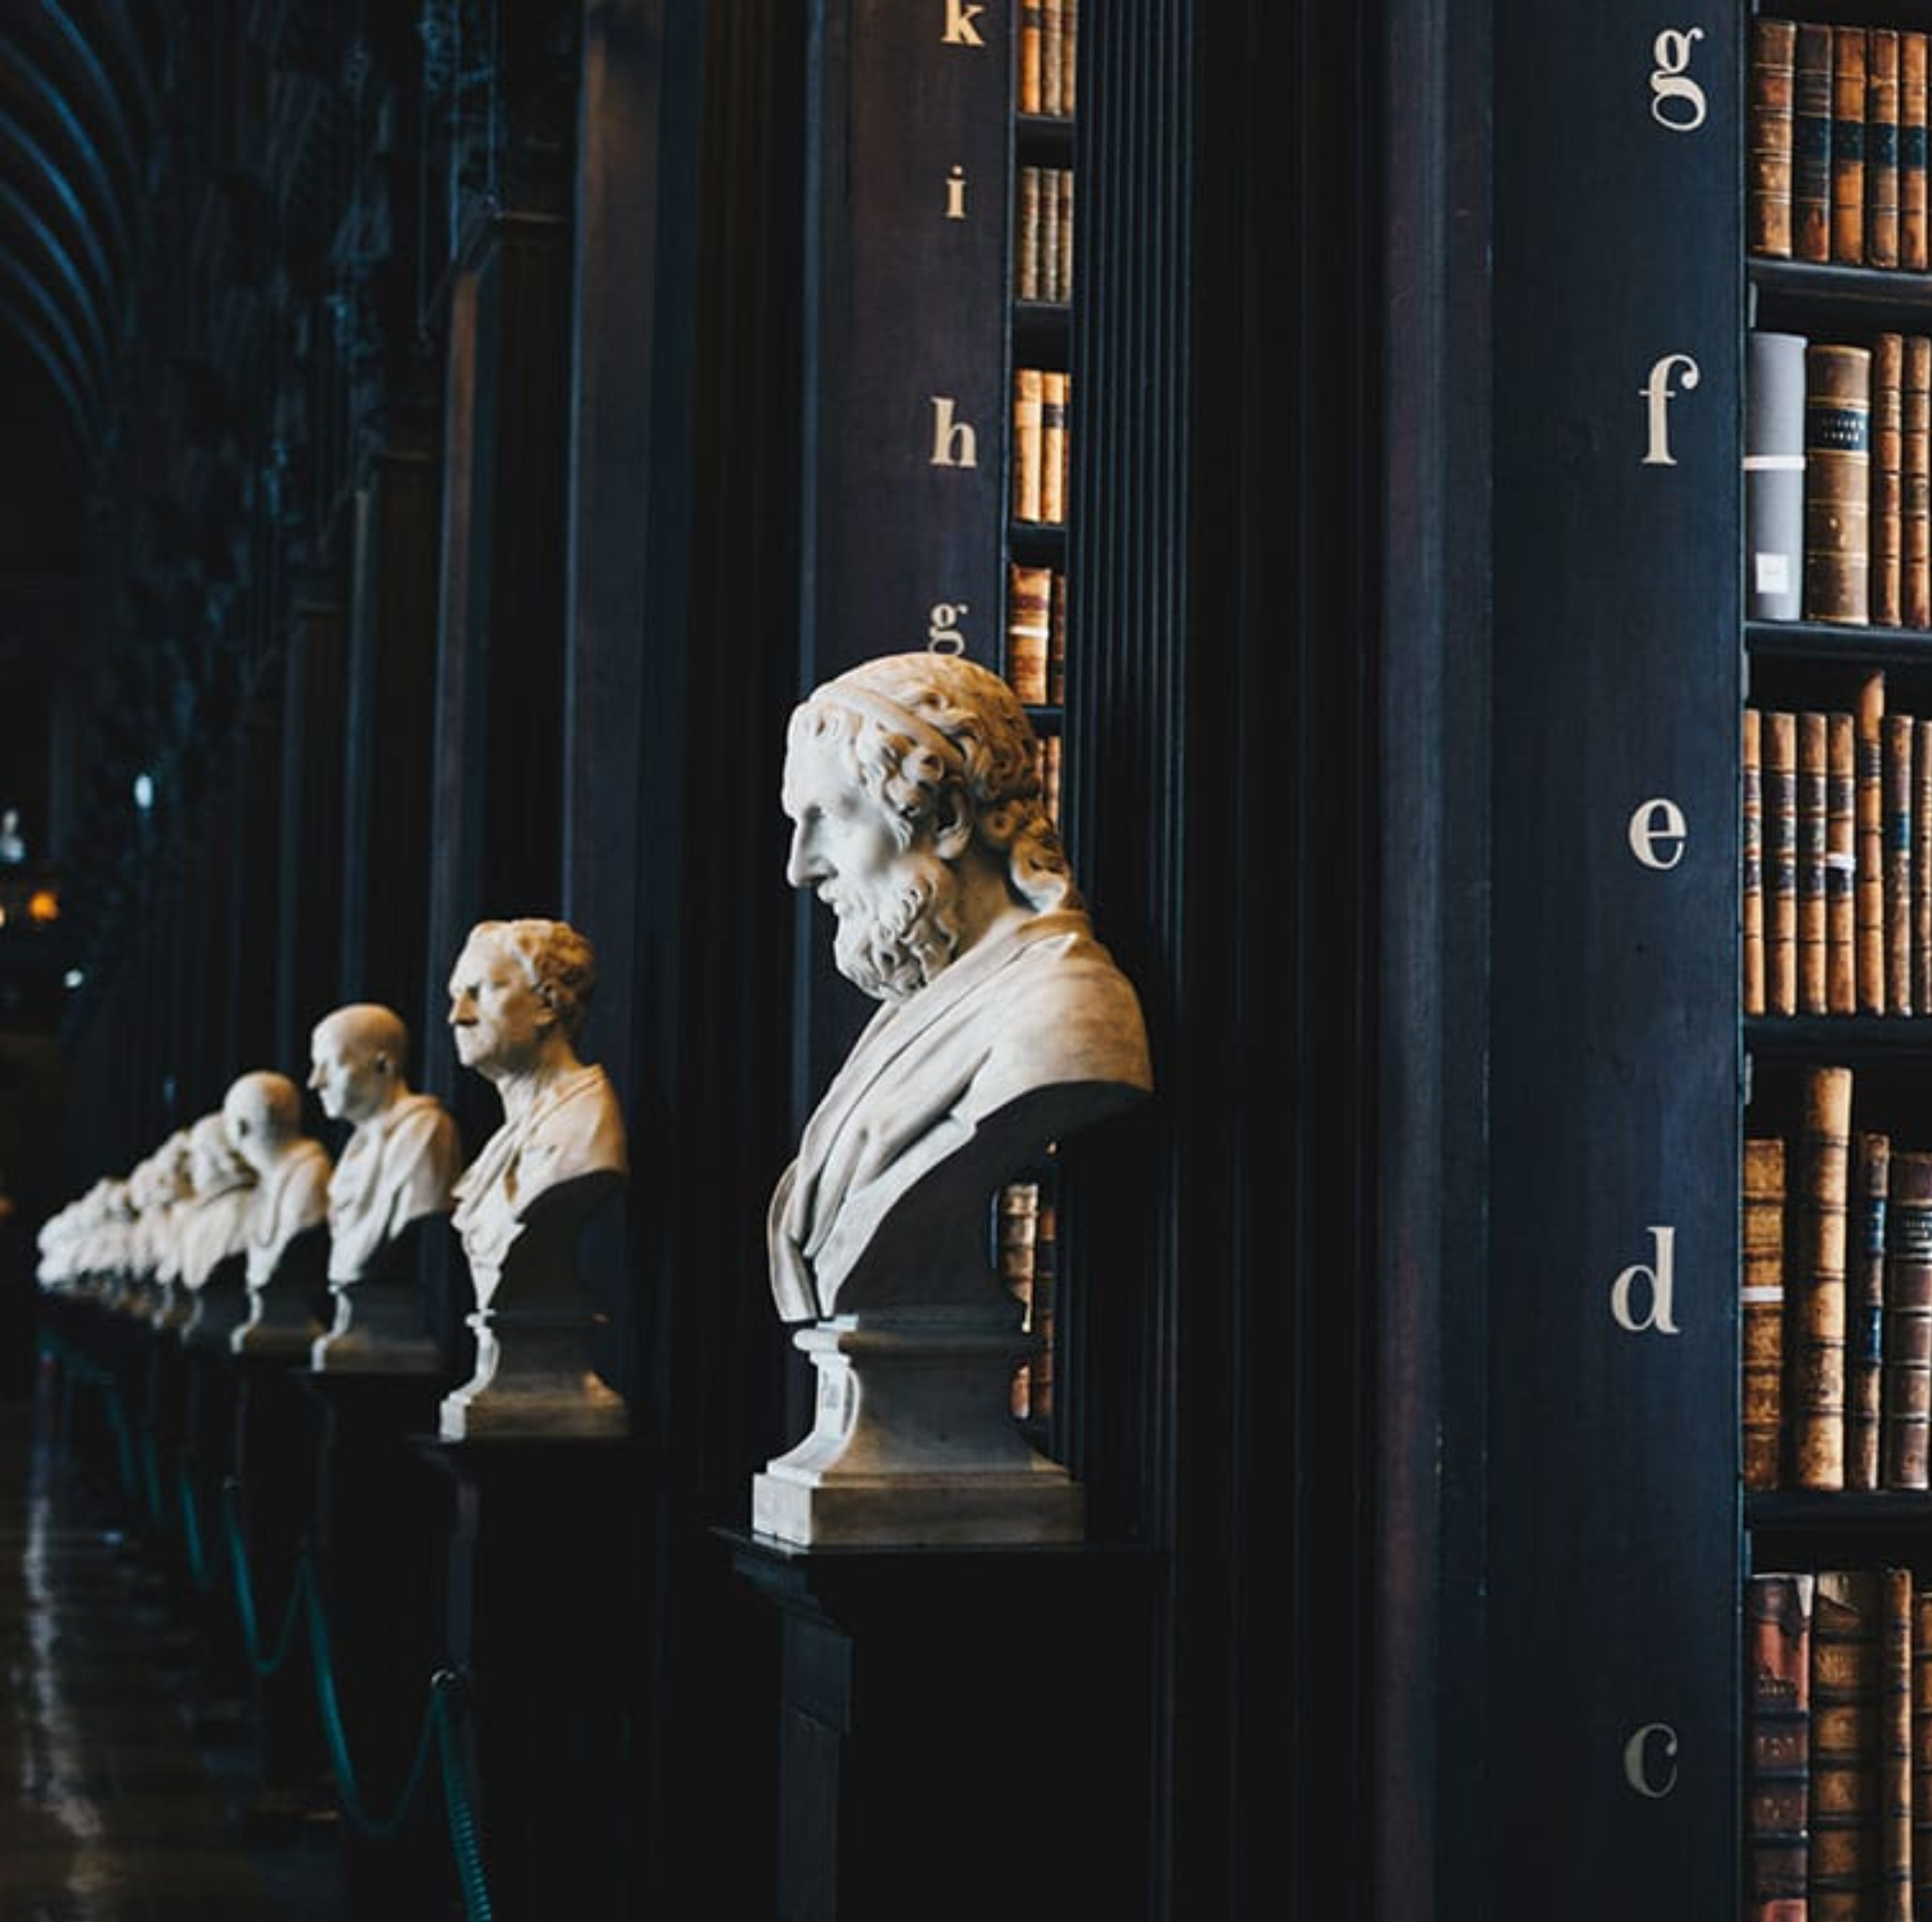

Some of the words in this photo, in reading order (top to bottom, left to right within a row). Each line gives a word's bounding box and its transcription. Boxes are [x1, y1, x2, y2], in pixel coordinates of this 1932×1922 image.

[941, 0, 985, 46] k
[1650, 27, 1706, 131] g
[945, 165, 967, 219] i
[929, 396, 977, 468] h
[1638, 354, 1699, 467] f
[929, 602, 968, 655] g
[1628, 798, 1687, 871] e
[1611, 1225, 1680, 1334] d
[1624, 1722, 1680, 1798] c
